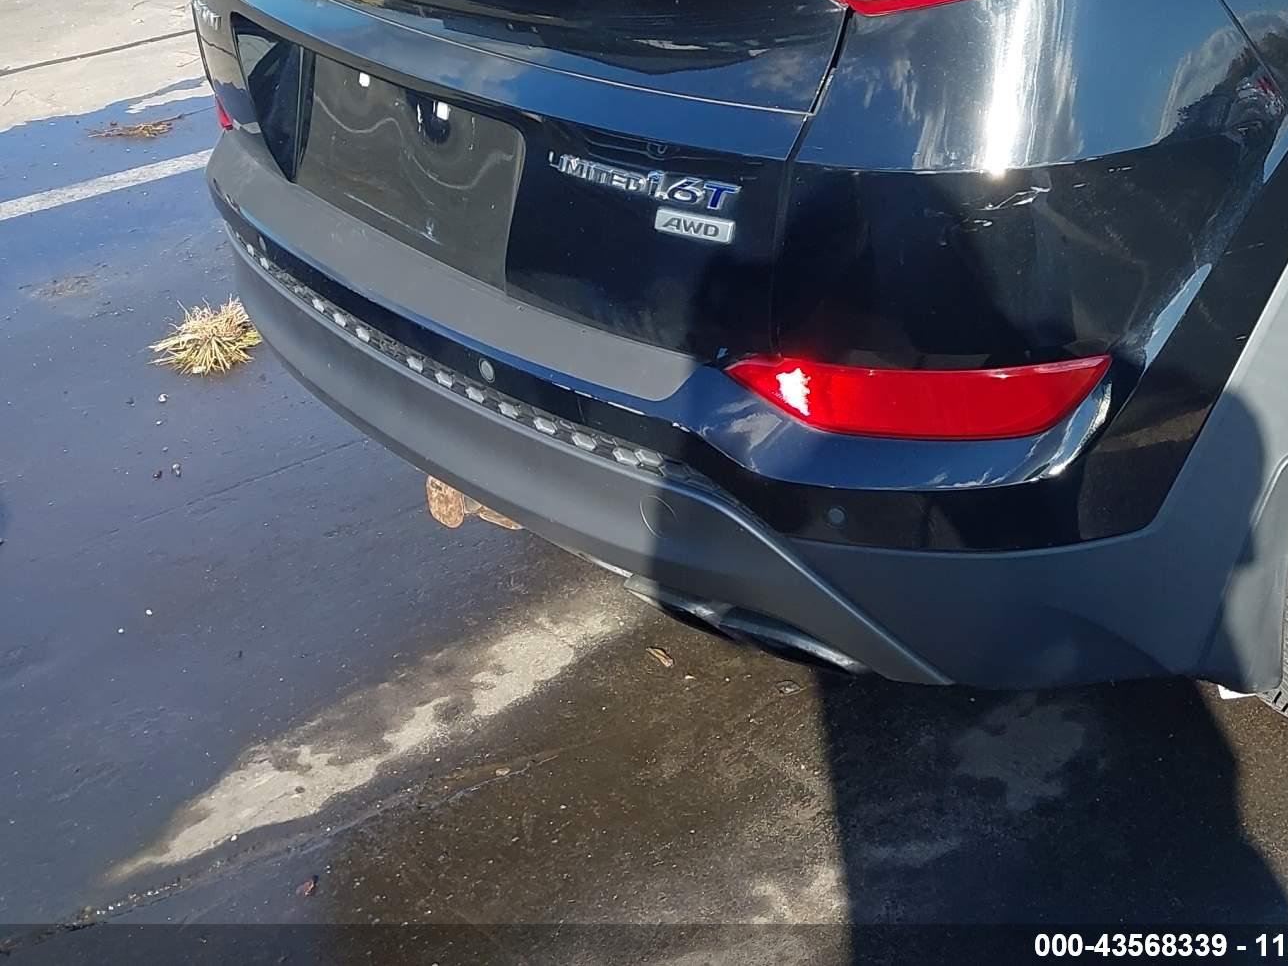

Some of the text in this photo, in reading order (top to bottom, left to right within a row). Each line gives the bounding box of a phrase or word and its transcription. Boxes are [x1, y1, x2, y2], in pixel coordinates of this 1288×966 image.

[548, 151, 743, 210] LIMITED 1.6T
[661, 216, 721, 239] AWD
